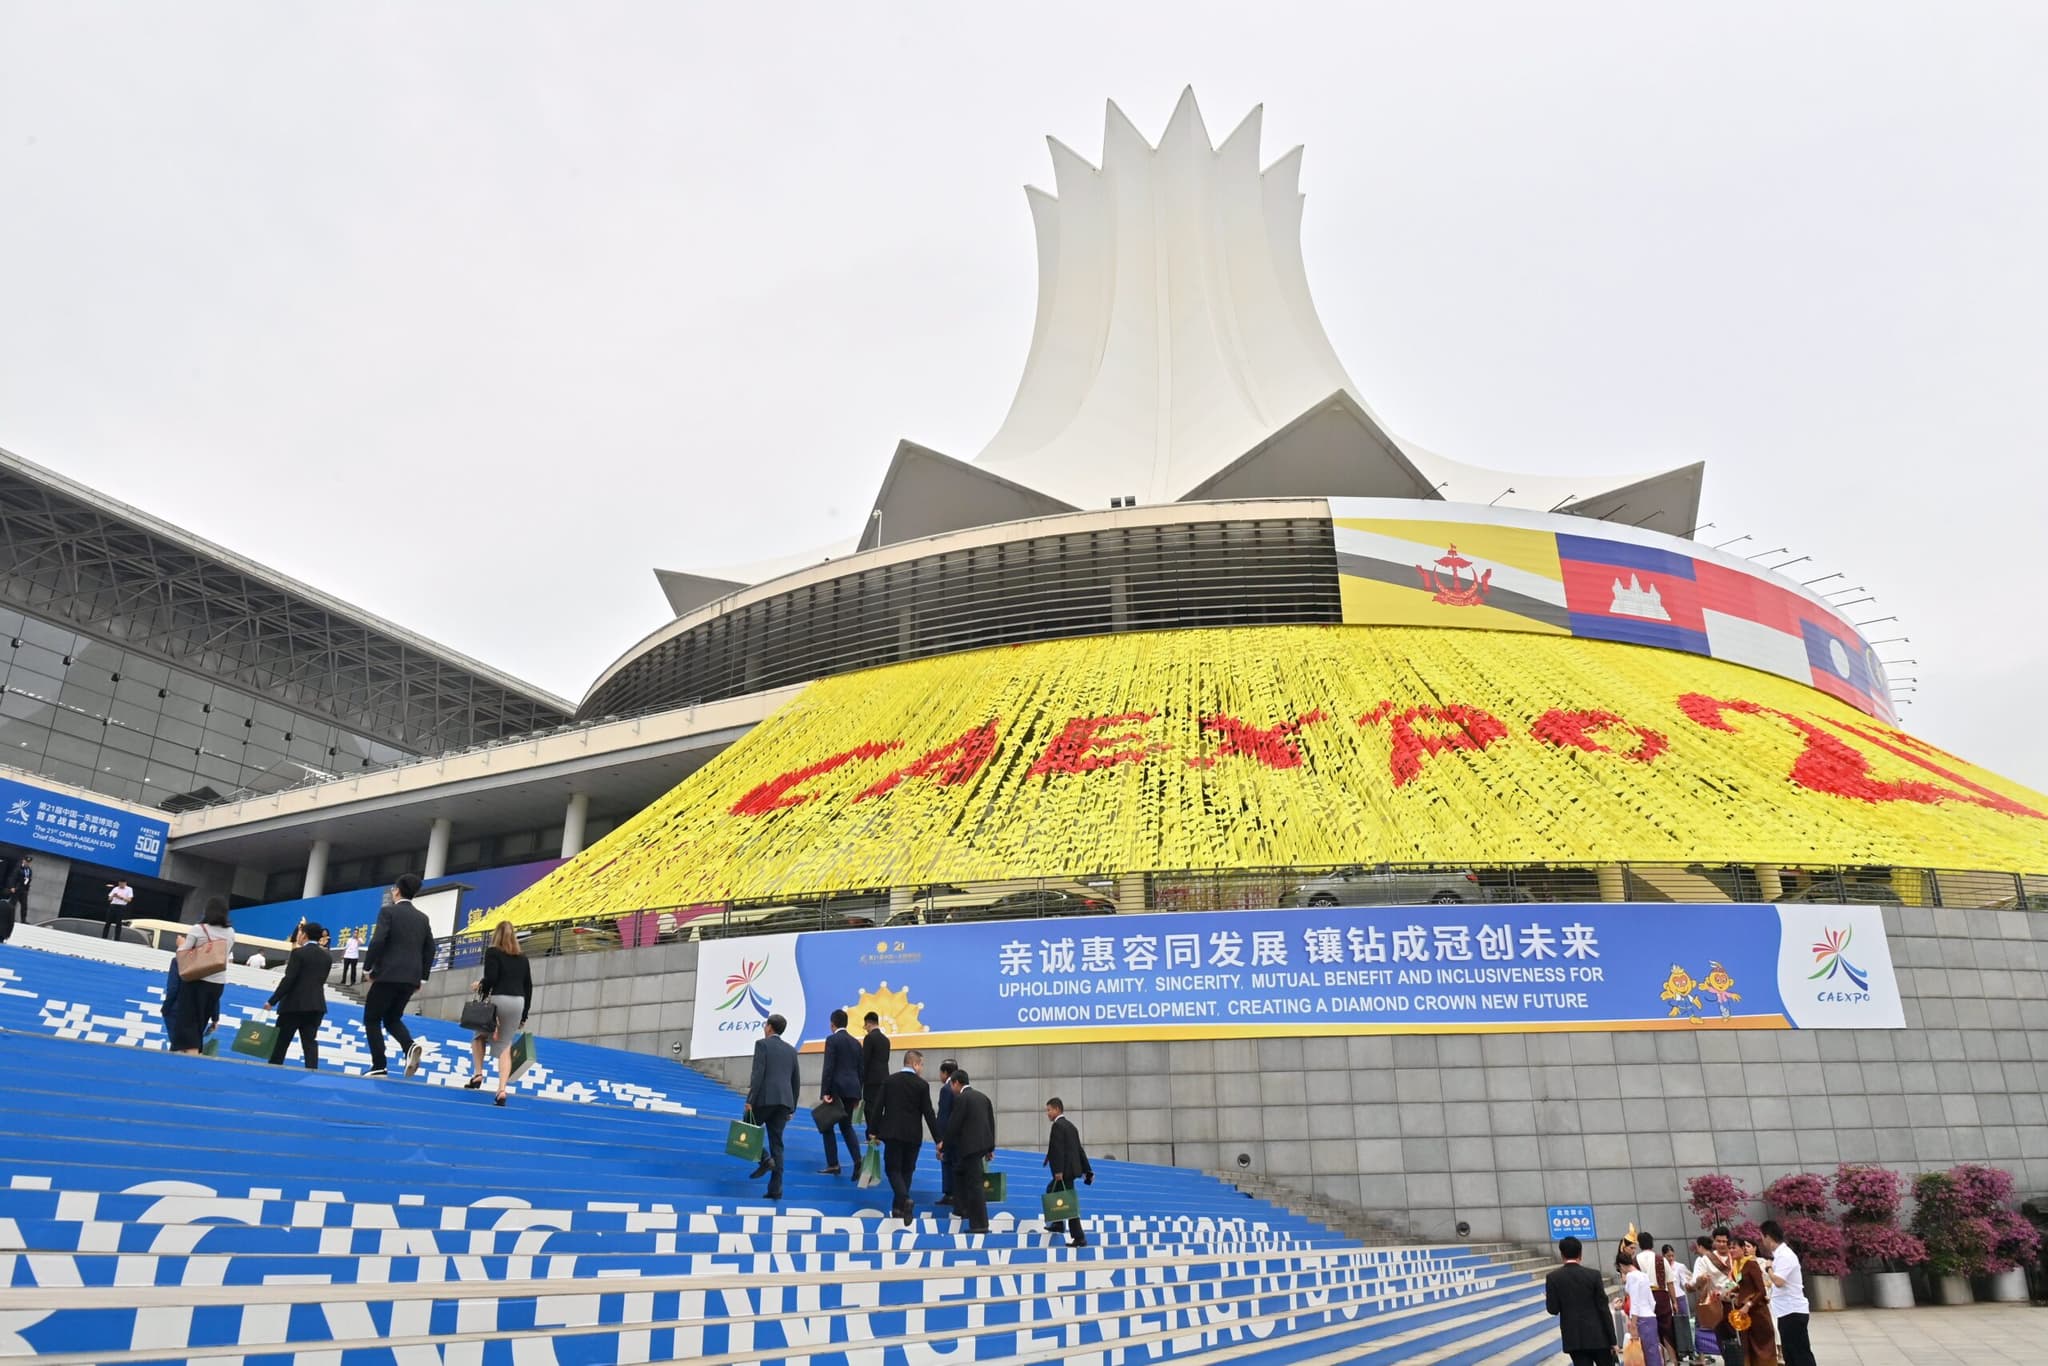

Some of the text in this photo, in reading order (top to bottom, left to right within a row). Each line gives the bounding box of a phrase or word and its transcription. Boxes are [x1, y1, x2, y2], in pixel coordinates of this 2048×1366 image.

[728, 700, 1668, 816] CAEXPO
[34, 824, 45, 833] The
[59, 831, 99, 846] CHINA-ASEAN
[100, 840, 116, 850] EXPO
[36, 811, 118, 838] 首席战略合作伙伴
[32, 832, 96, 852] Chief Strategic Partner
[134, 835, 161, 855] 500
[1000, 922, 1600, 976] 亲诚惠容同发展 镶钻成冠创未来
[1000, 979, 1091, 998] UPHOLDING
[1251, 971, 1320, 989] MUTUAL
[1324, 970, 1394, 986] BENEFIT
[1398, 969, 1432, 984] AND
[1437, 967, 1566, 983] INCLUSIVENESS
[1570, 966, 1604, 982] FOR
[1018, 1004, 1091, 1022] COMMON
[1227, 998, 1311, 1015] CREATING
[1315, 997, 1328, 1013] A
[1331, 996, 1409, 1012] DIAMOND
[1414, 994, 1477, 1011] CROWN
[1481, 993, 1520, 1009] NEW
[1523, 993, 1589, 1009] FUTURE
[1816, 991, 1871, 1005] CAEXPO
